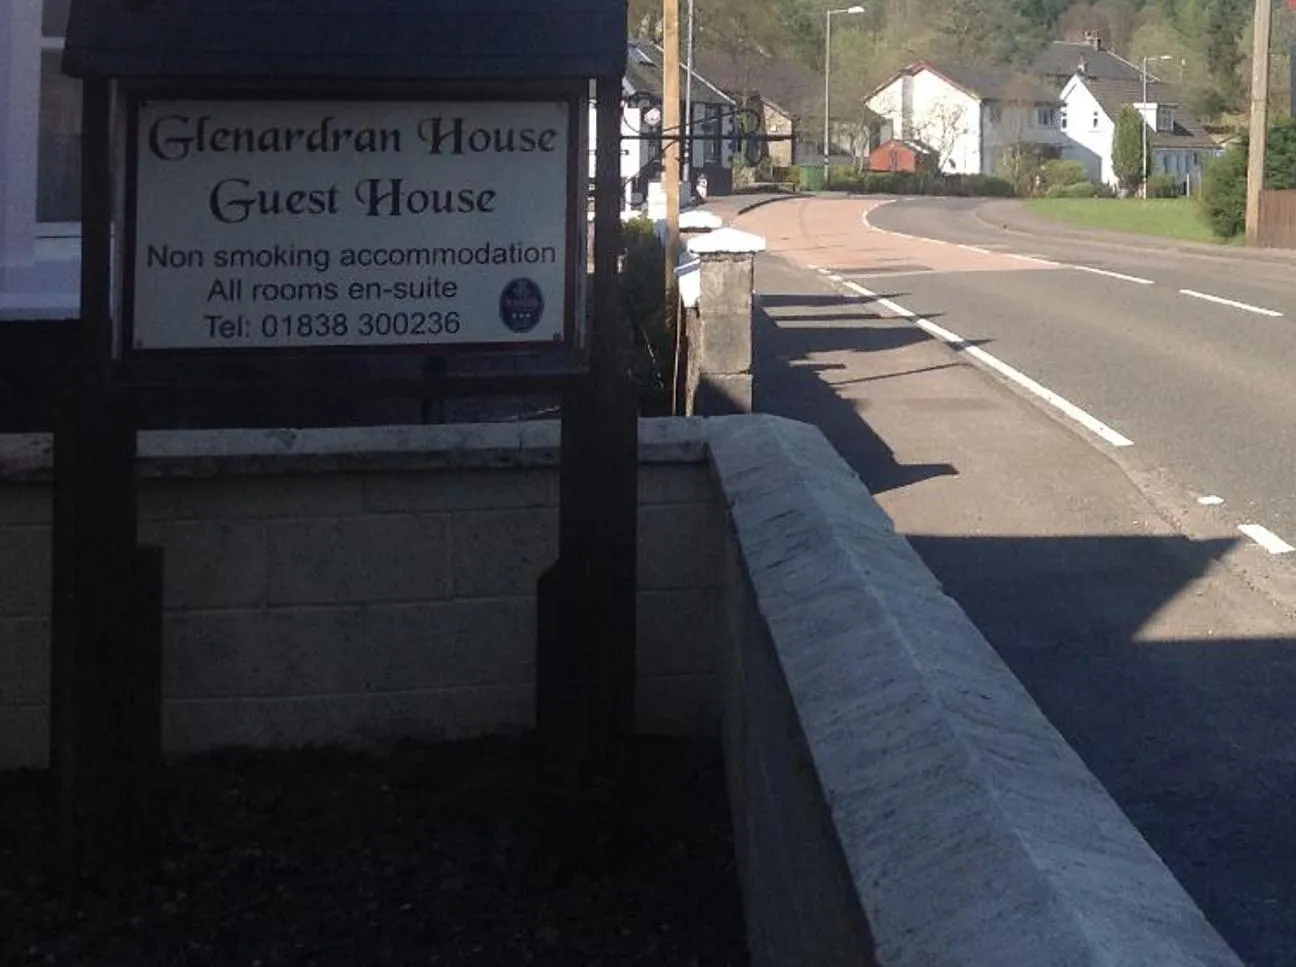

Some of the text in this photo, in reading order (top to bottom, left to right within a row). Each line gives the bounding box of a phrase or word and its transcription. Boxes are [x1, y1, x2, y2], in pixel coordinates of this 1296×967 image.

[149, 115, 557, 161] Glenardran House
[209, 178, 497, 224] Guest House
[147, 242, 556, 272] Non smoking accommodation
[207, 276, 458, 302] All rooms en-suite
[204, 311, 461, 339] Tel: 01838 300236
